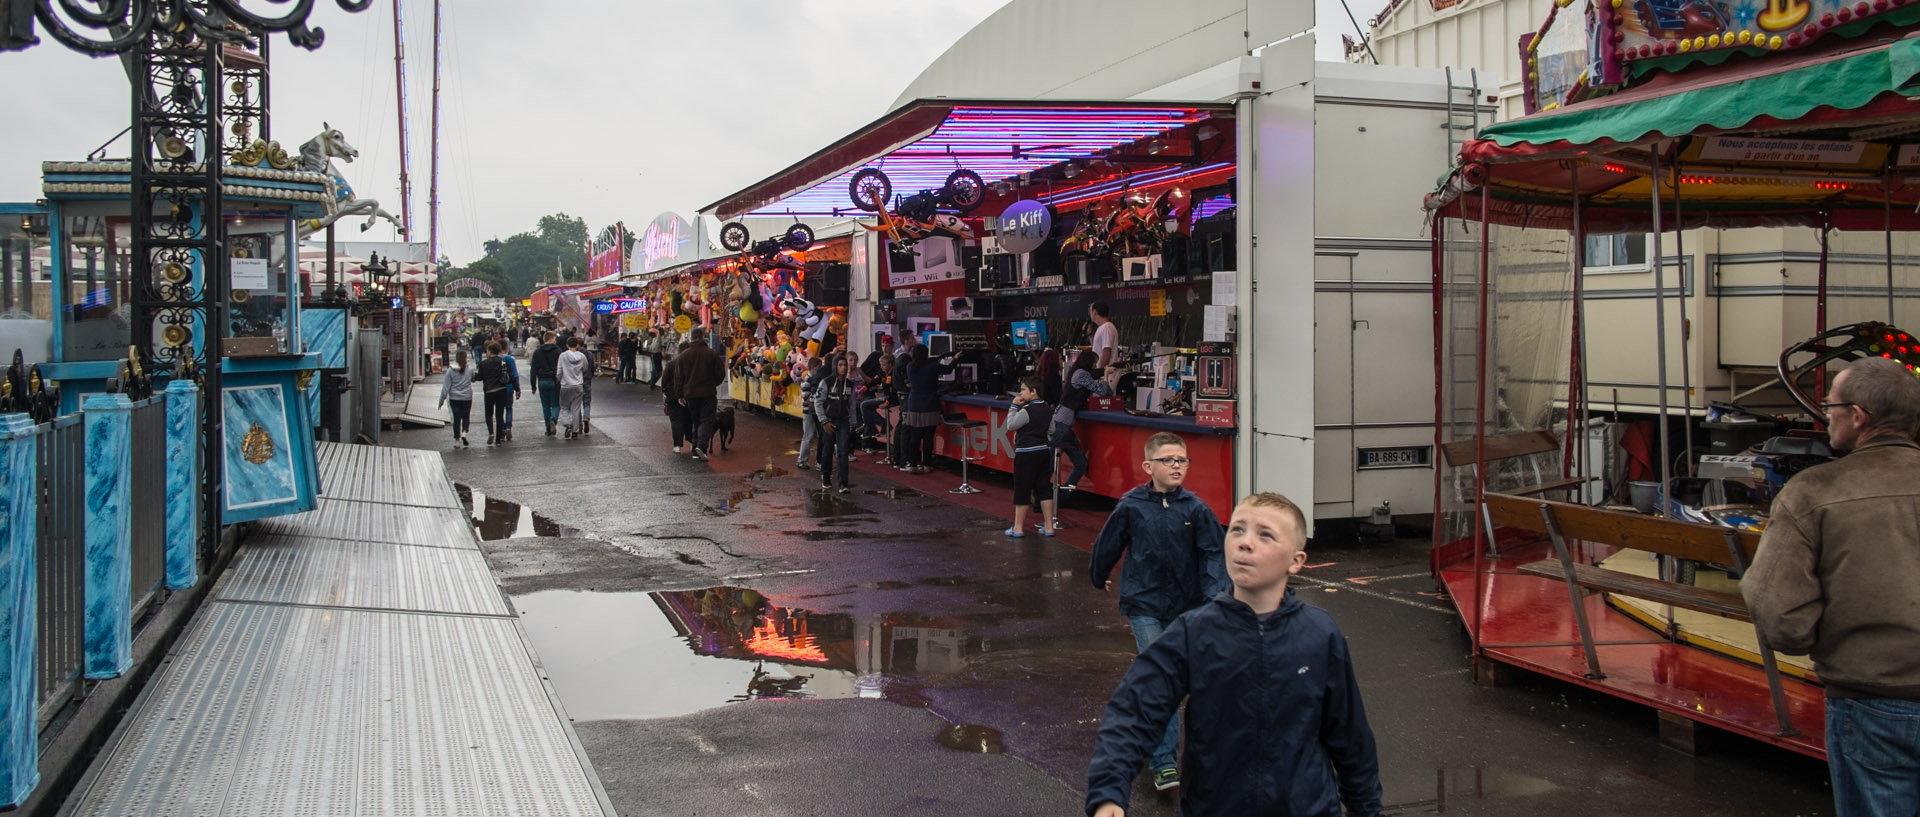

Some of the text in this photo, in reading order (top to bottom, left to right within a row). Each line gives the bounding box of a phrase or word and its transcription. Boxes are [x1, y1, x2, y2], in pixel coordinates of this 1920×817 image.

[1718, 138, 1853, 152] Nous acceptons les enfants
[1753, 152, 1781, 161] partir
[1784, 151, 1805, 160] d'un
[1807, 153, 1820, 161] an
[1003, 209, 1043, 231] Le Kiff
[892, 275, 916, 285] PS3
[924, 272, 938, 281] Wii
[1024, 306, 1049, 318] SONY
[1099, 398, 1111, 406] Wii
[1369, 451, 1411, 463] BA-689-CW
